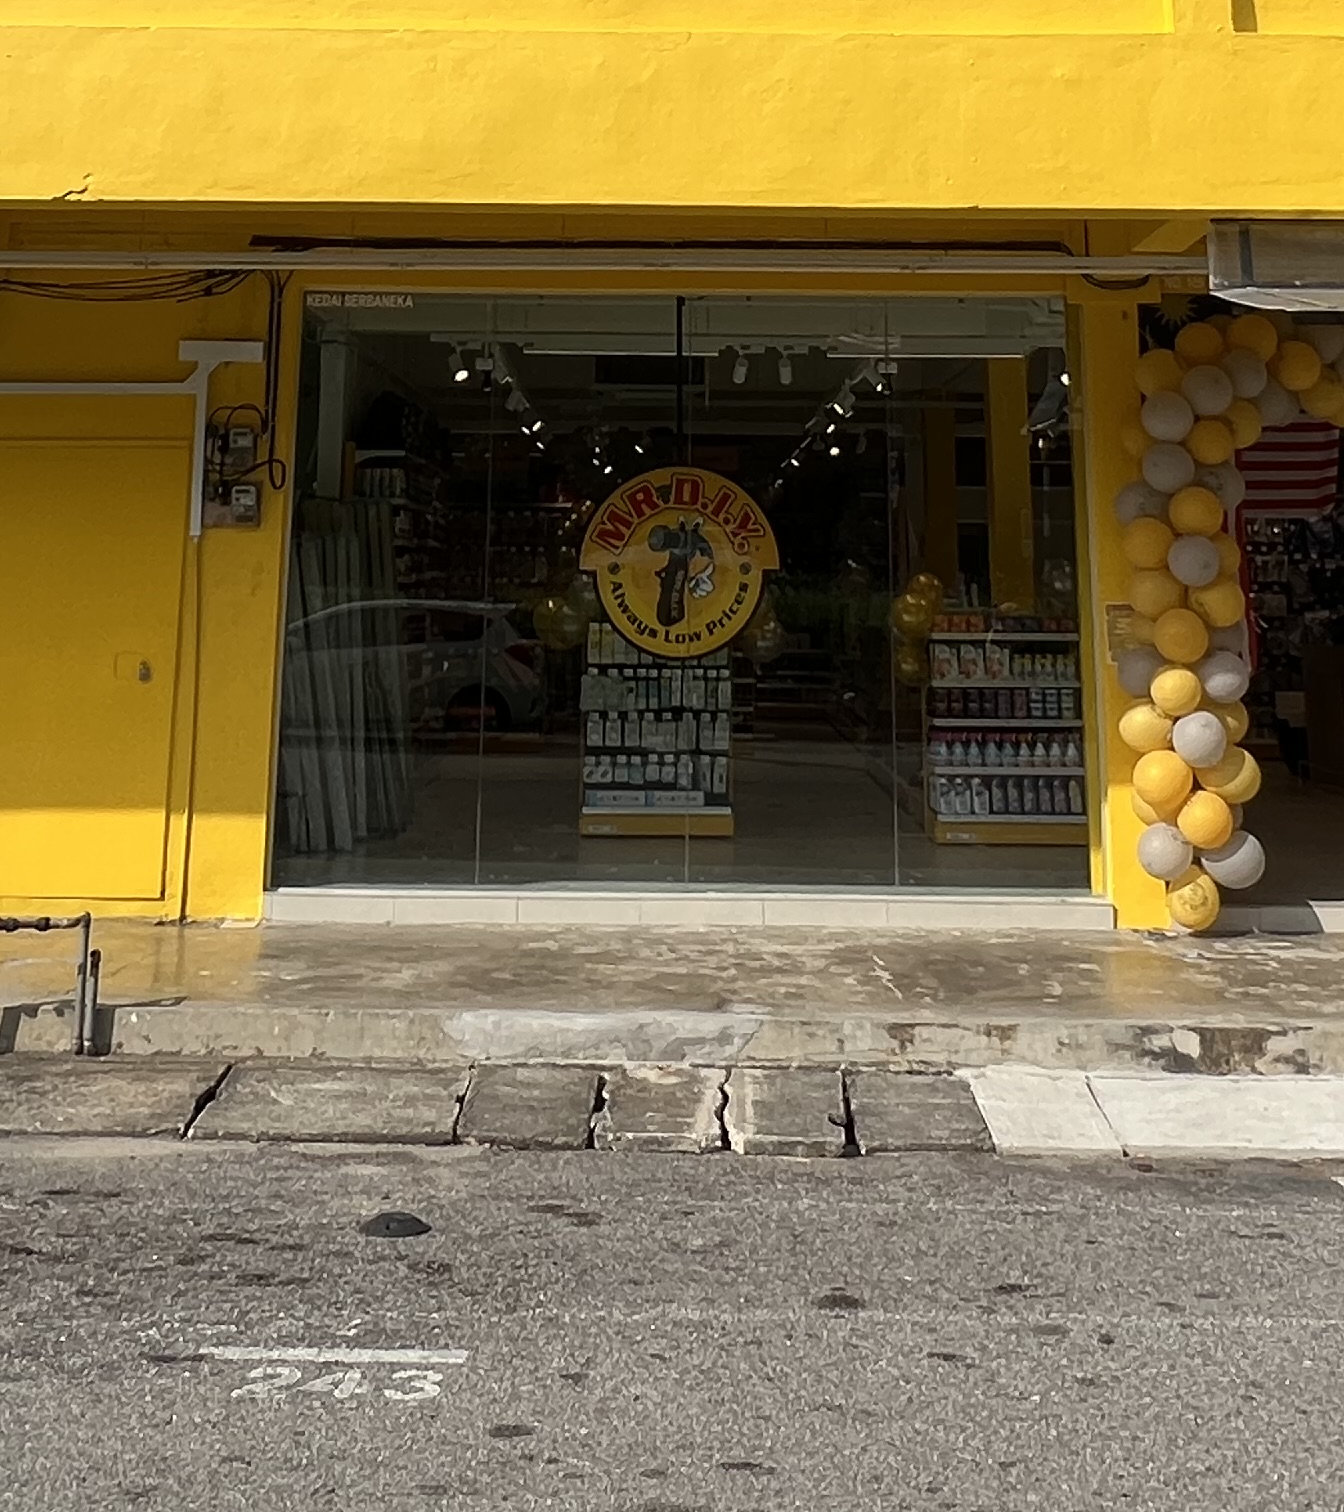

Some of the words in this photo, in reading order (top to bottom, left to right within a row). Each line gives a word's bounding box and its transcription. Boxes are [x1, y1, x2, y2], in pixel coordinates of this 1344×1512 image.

[610, 579, 659, 640] Always
[664, 629, 702, 645] Low
[705, 580, 750, 636] Prices
[230, 1366, 443, 1399] 243
